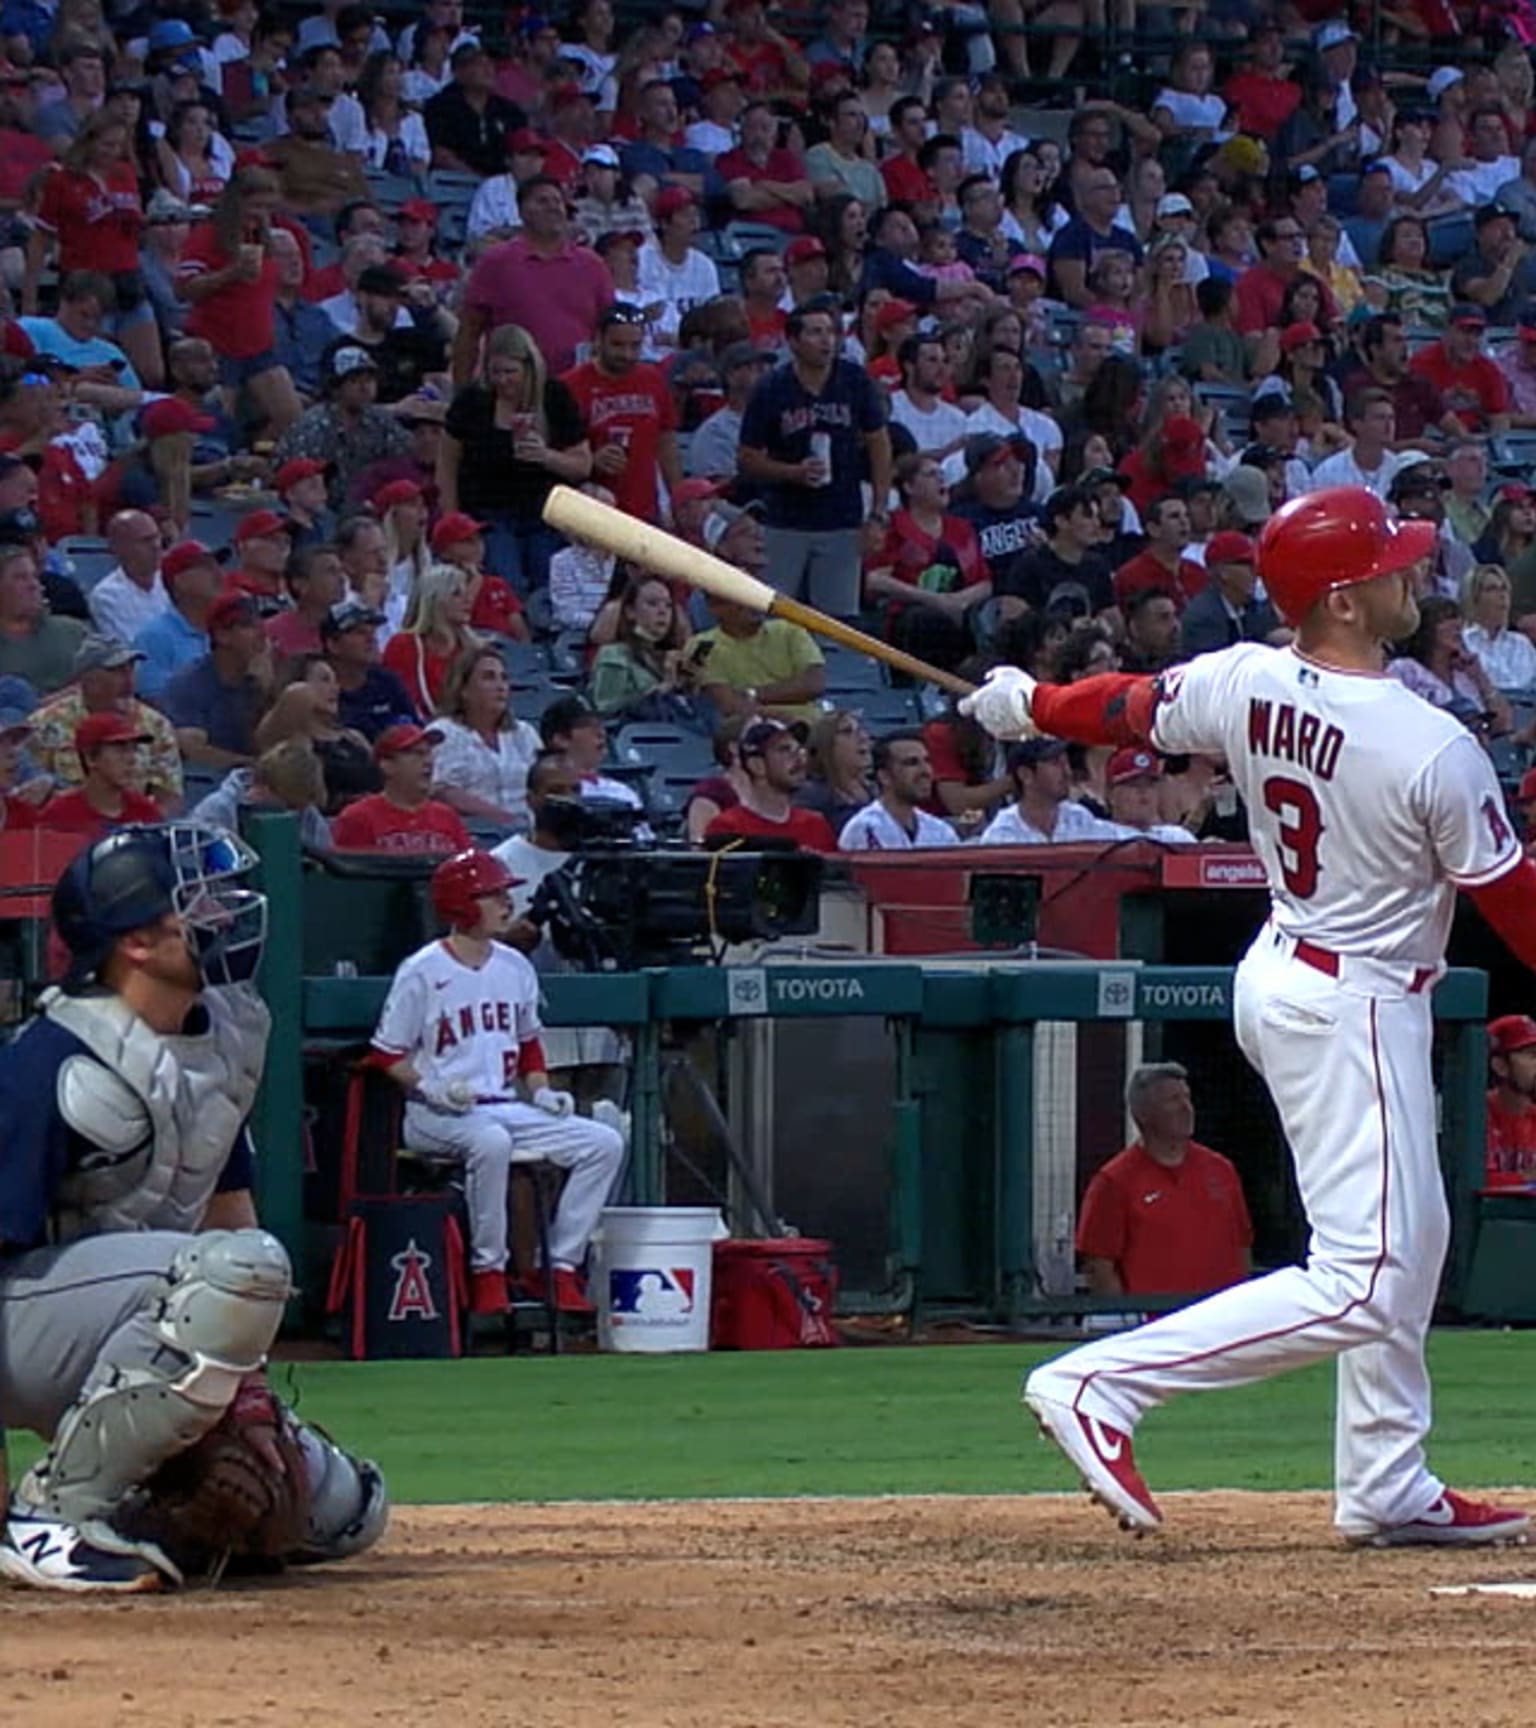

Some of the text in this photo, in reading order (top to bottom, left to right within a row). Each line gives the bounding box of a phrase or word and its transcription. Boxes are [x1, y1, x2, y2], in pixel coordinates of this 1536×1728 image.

[1250, 698, 1345, 781] WARD
[1264, 776, 1325, 900] 3
[774, 978, 864, 999] TOYOTA
[1142, 984, 1225, 1006] TOYOTA
[387, 1238, 439, 1321] A
